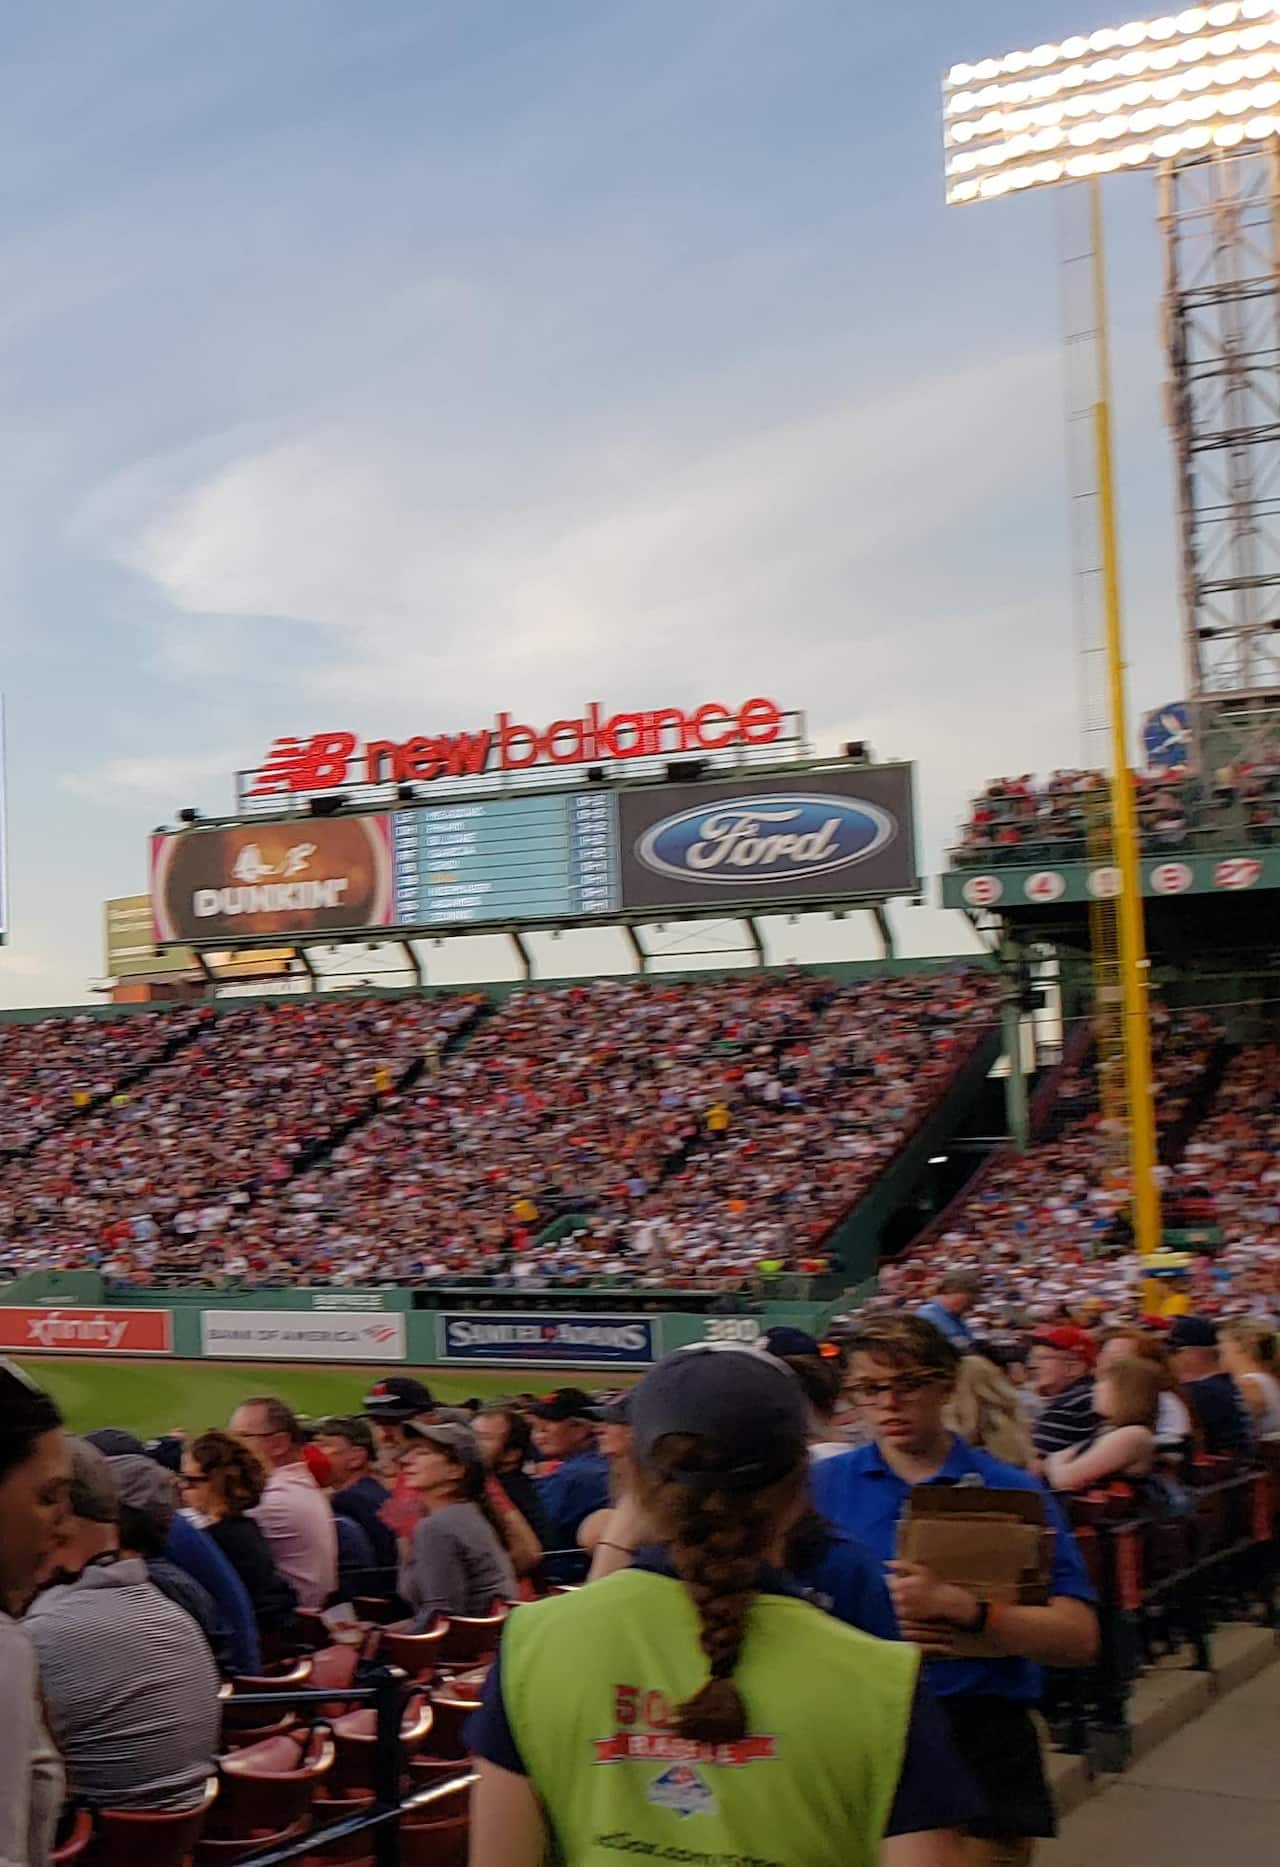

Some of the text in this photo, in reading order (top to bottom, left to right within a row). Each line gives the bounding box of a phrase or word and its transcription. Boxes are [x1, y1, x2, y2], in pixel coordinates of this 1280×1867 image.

[686, 808, 843, 869] Ford
[26, 1311, 128, 1348] xfinity
[448, 1320, 647, 1351] SAMUEL ADAMS
[703, 1318, 761, 1341] 380
